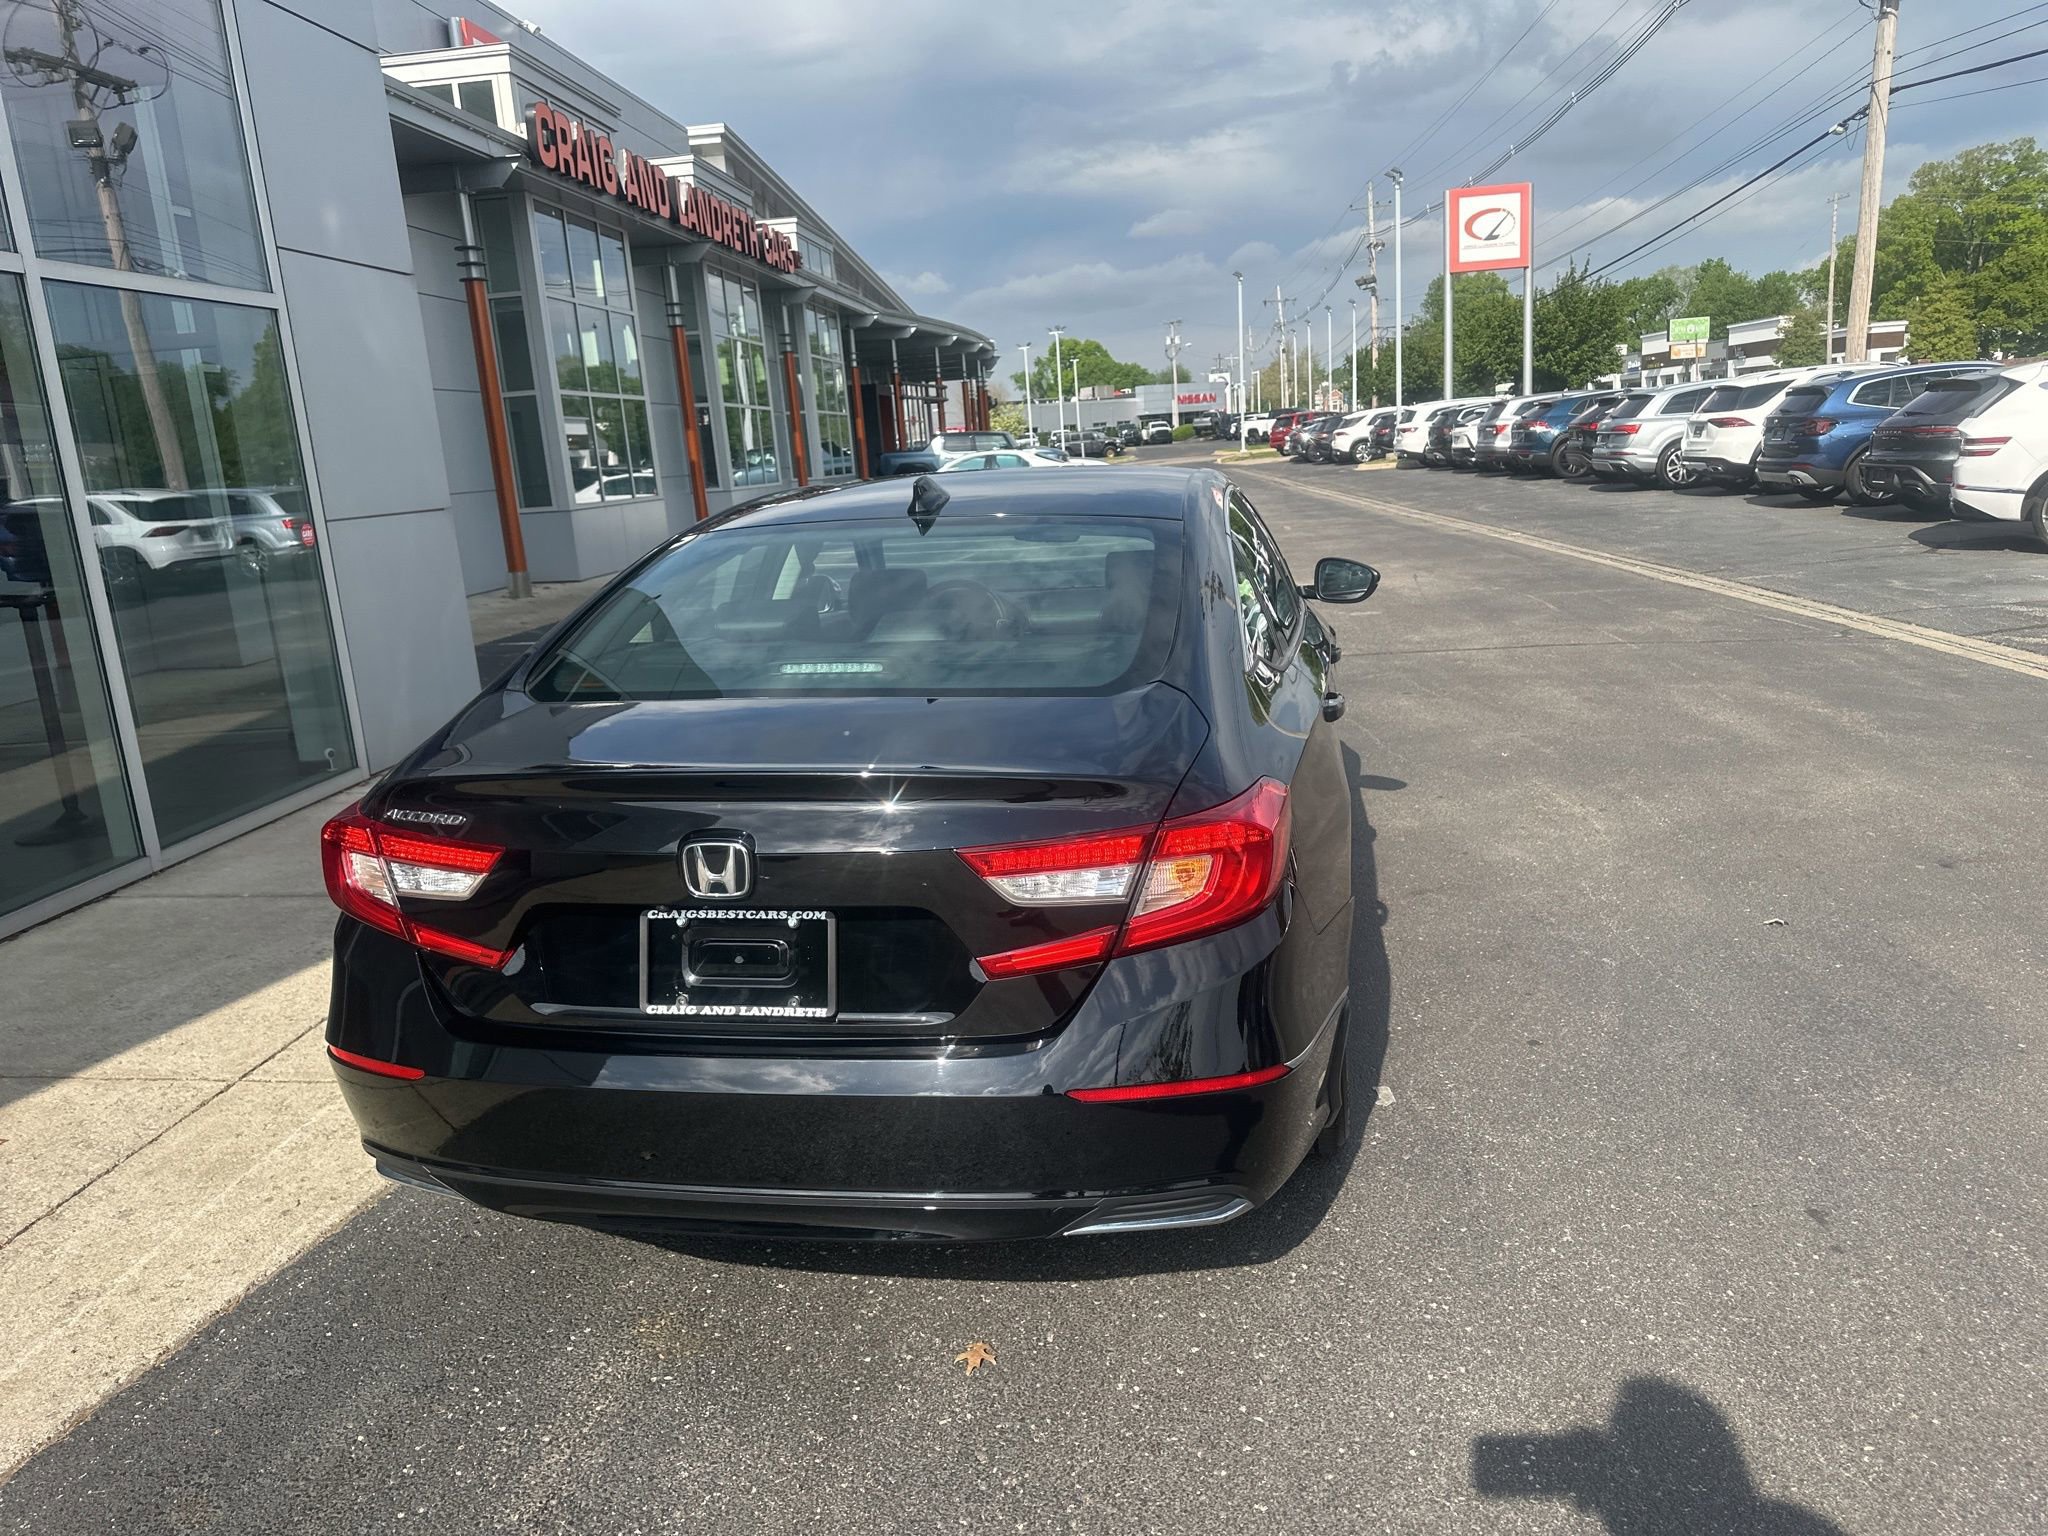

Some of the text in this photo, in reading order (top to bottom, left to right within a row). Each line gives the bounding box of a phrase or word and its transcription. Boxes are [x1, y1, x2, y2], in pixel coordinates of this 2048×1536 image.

[533, 101, 796, 274] CRAIG AND LANDRETH CARS
[1177, 391, 1217, 405] NISSAN
[383, 808, 467, 826] ACCORD
[647, 909, 827, 920] CRAIGSBESTCARS.COM
[646, 1005, 828, 1017] CRAIG AND LANDRETH
